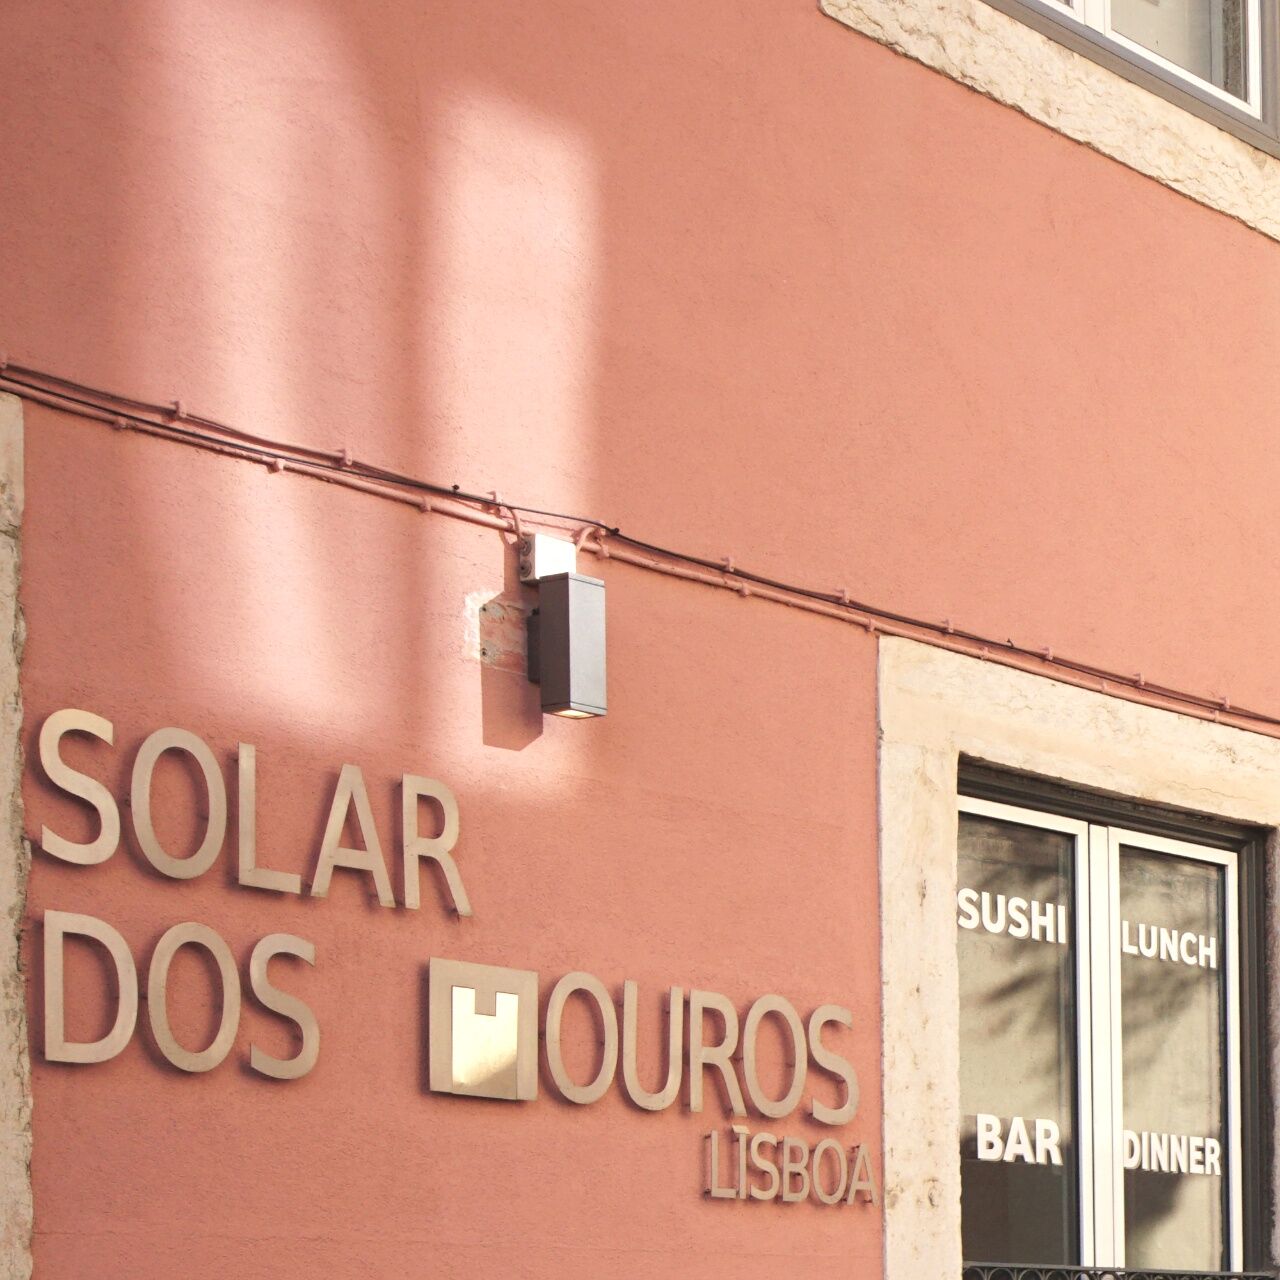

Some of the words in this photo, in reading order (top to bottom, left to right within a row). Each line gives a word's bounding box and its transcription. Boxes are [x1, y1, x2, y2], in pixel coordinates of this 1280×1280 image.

[38, 708, 471, 916] SOLAR
[957, 887, 1067, 944] SUSHI
[1122, 920, 1217, 969] LUNCH
[43, 909, 321, 1080] DOS
[706, 1125, 877, 1205] LISBOA
[976, 1113, 1063, 1166] BAR
[1123, 1130, 1222, 1176] DINNER
